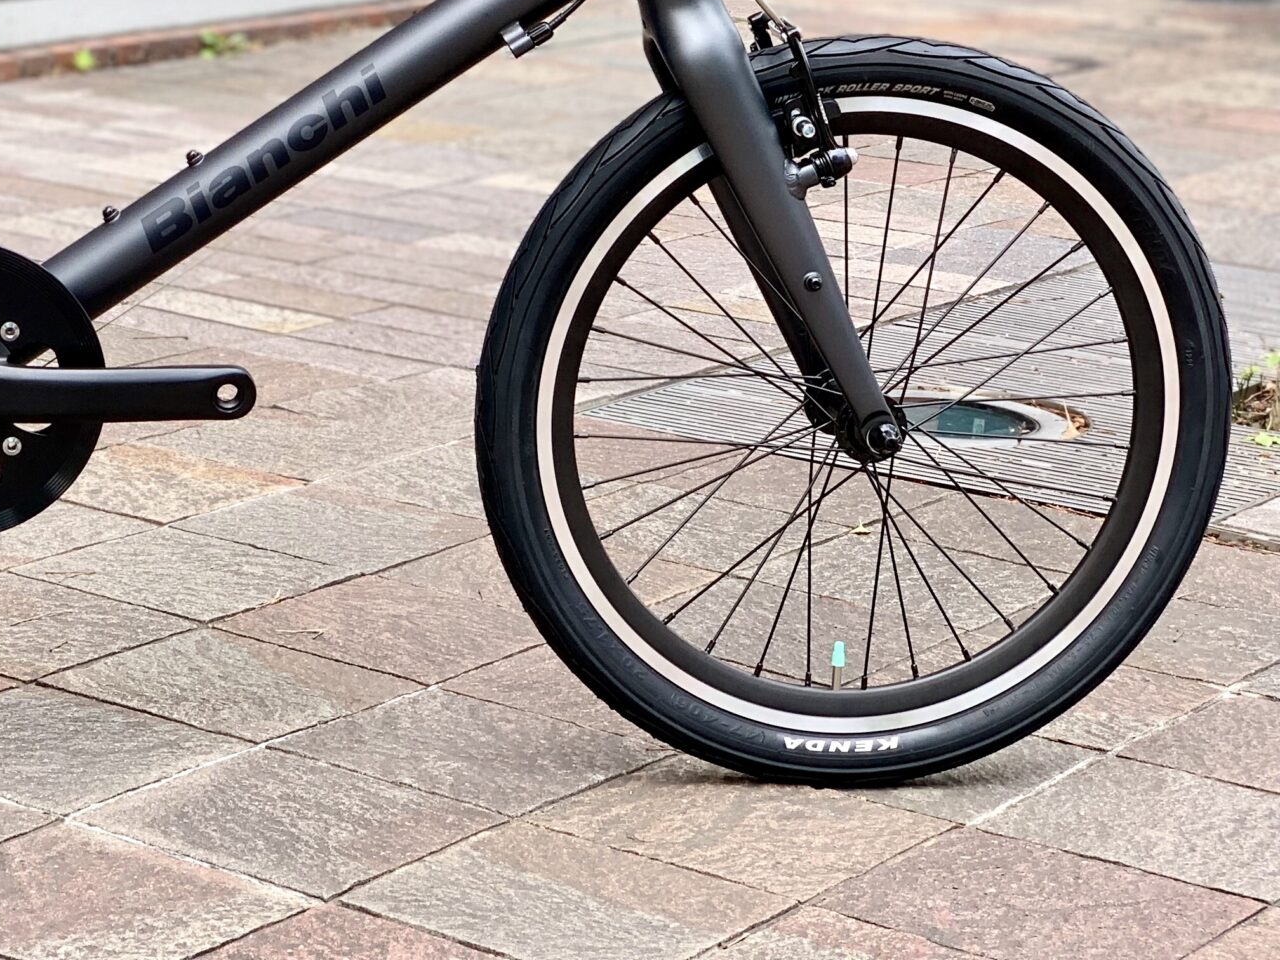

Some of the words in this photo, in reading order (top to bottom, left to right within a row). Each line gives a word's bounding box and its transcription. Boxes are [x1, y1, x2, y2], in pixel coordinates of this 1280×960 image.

[836, 82, 889, 93] ROLLER
[893, 83, 941, 95] SPORT
[140, 62, 386, 254] Bianchi
[783, 736, 900, 753] KENDA
